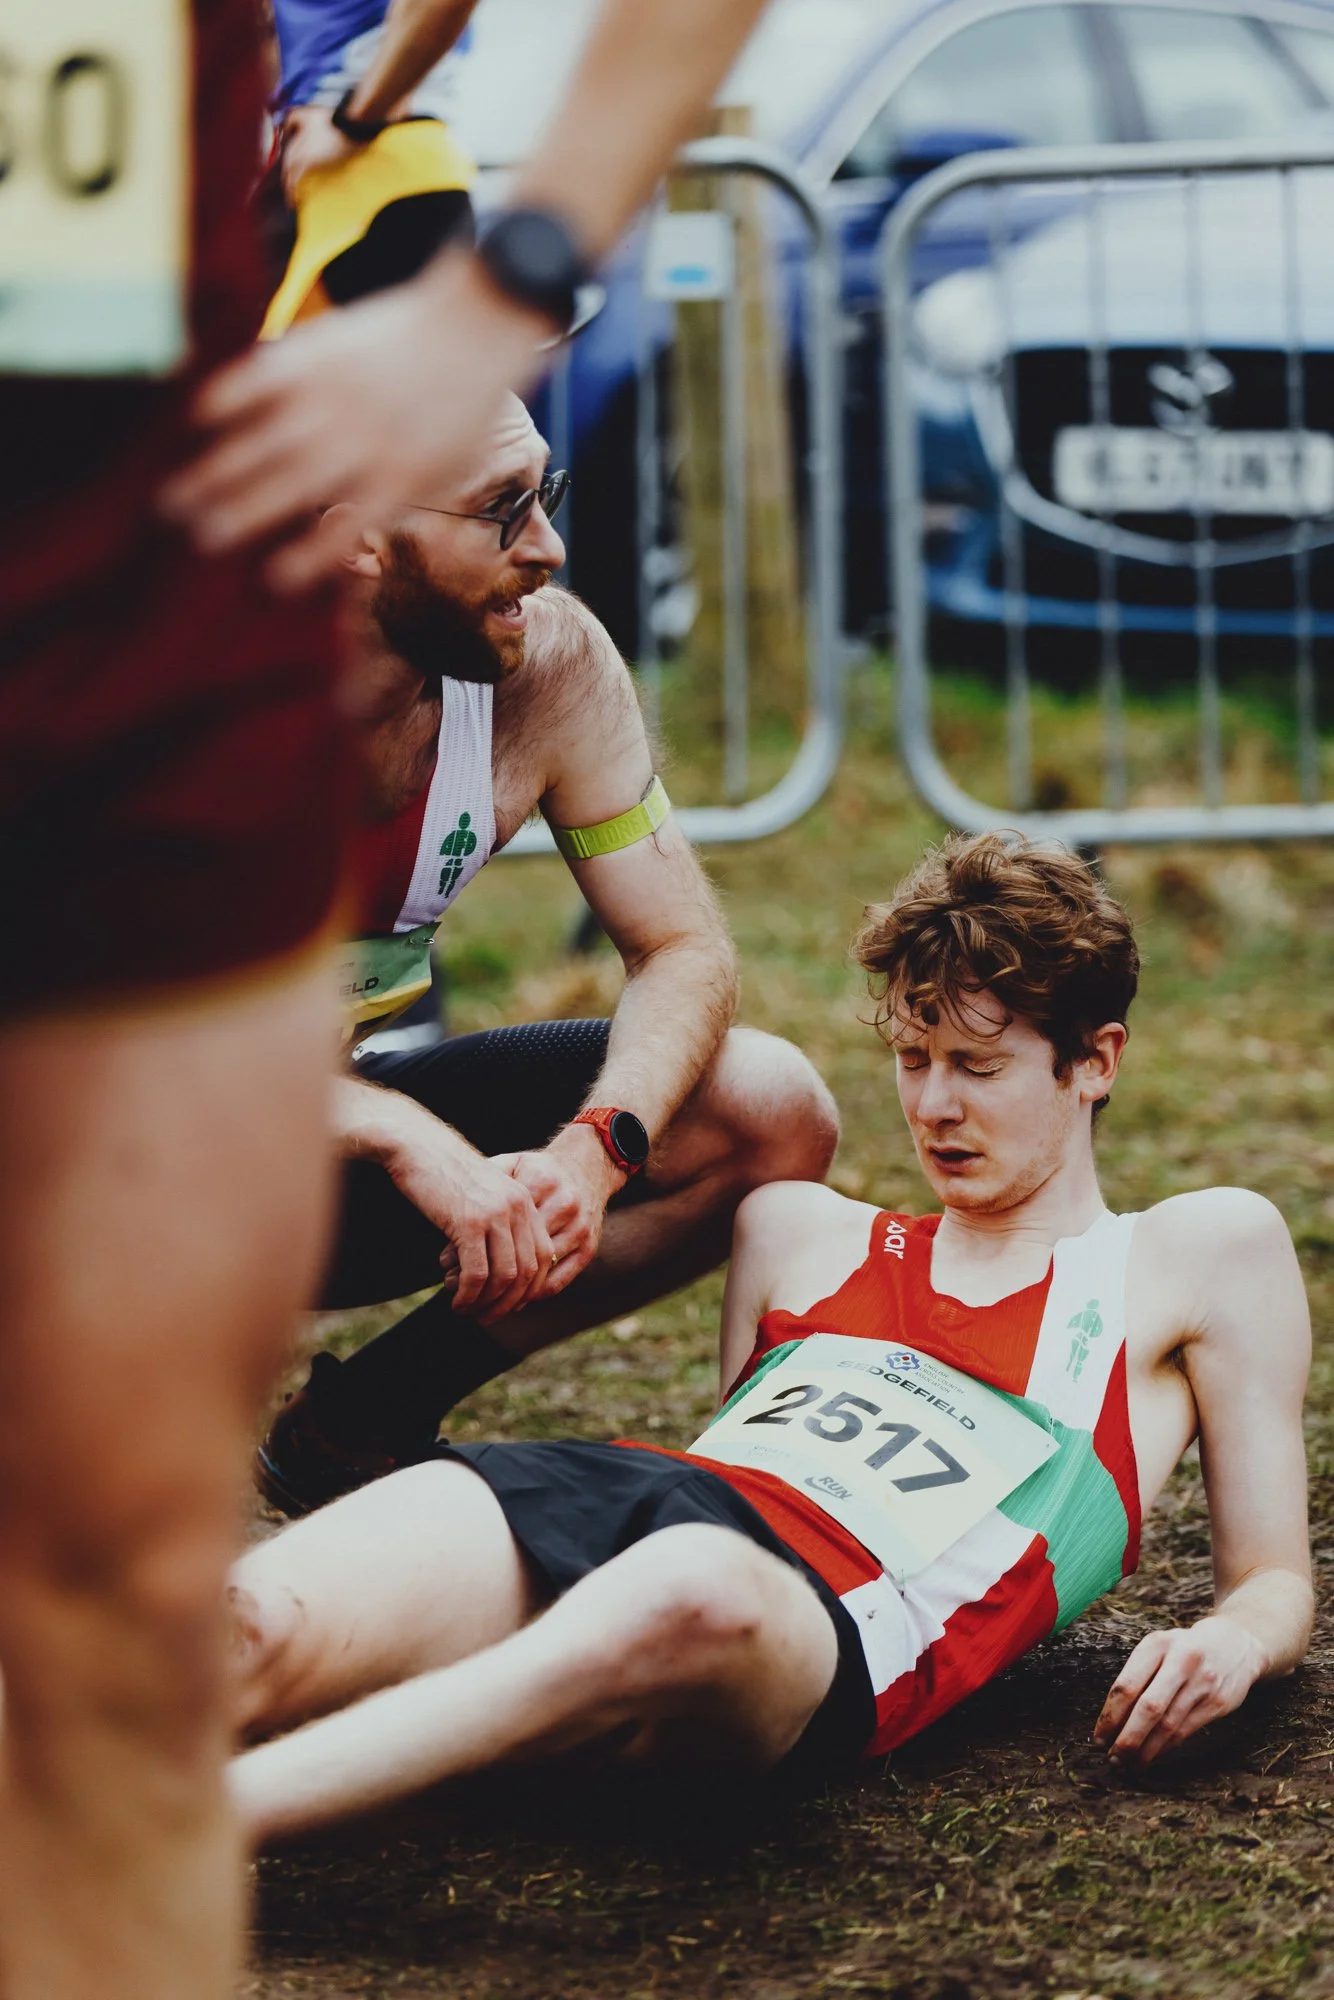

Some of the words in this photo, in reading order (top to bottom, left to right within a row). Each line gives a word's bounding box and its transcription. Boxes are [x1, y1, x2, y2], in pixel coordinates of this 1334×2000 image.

[836, 1359, 976, 1431] SEDGEFIELD
[742, 1384, 971, 1493] 2517
[817, 1475, 853, 1501] RUN
